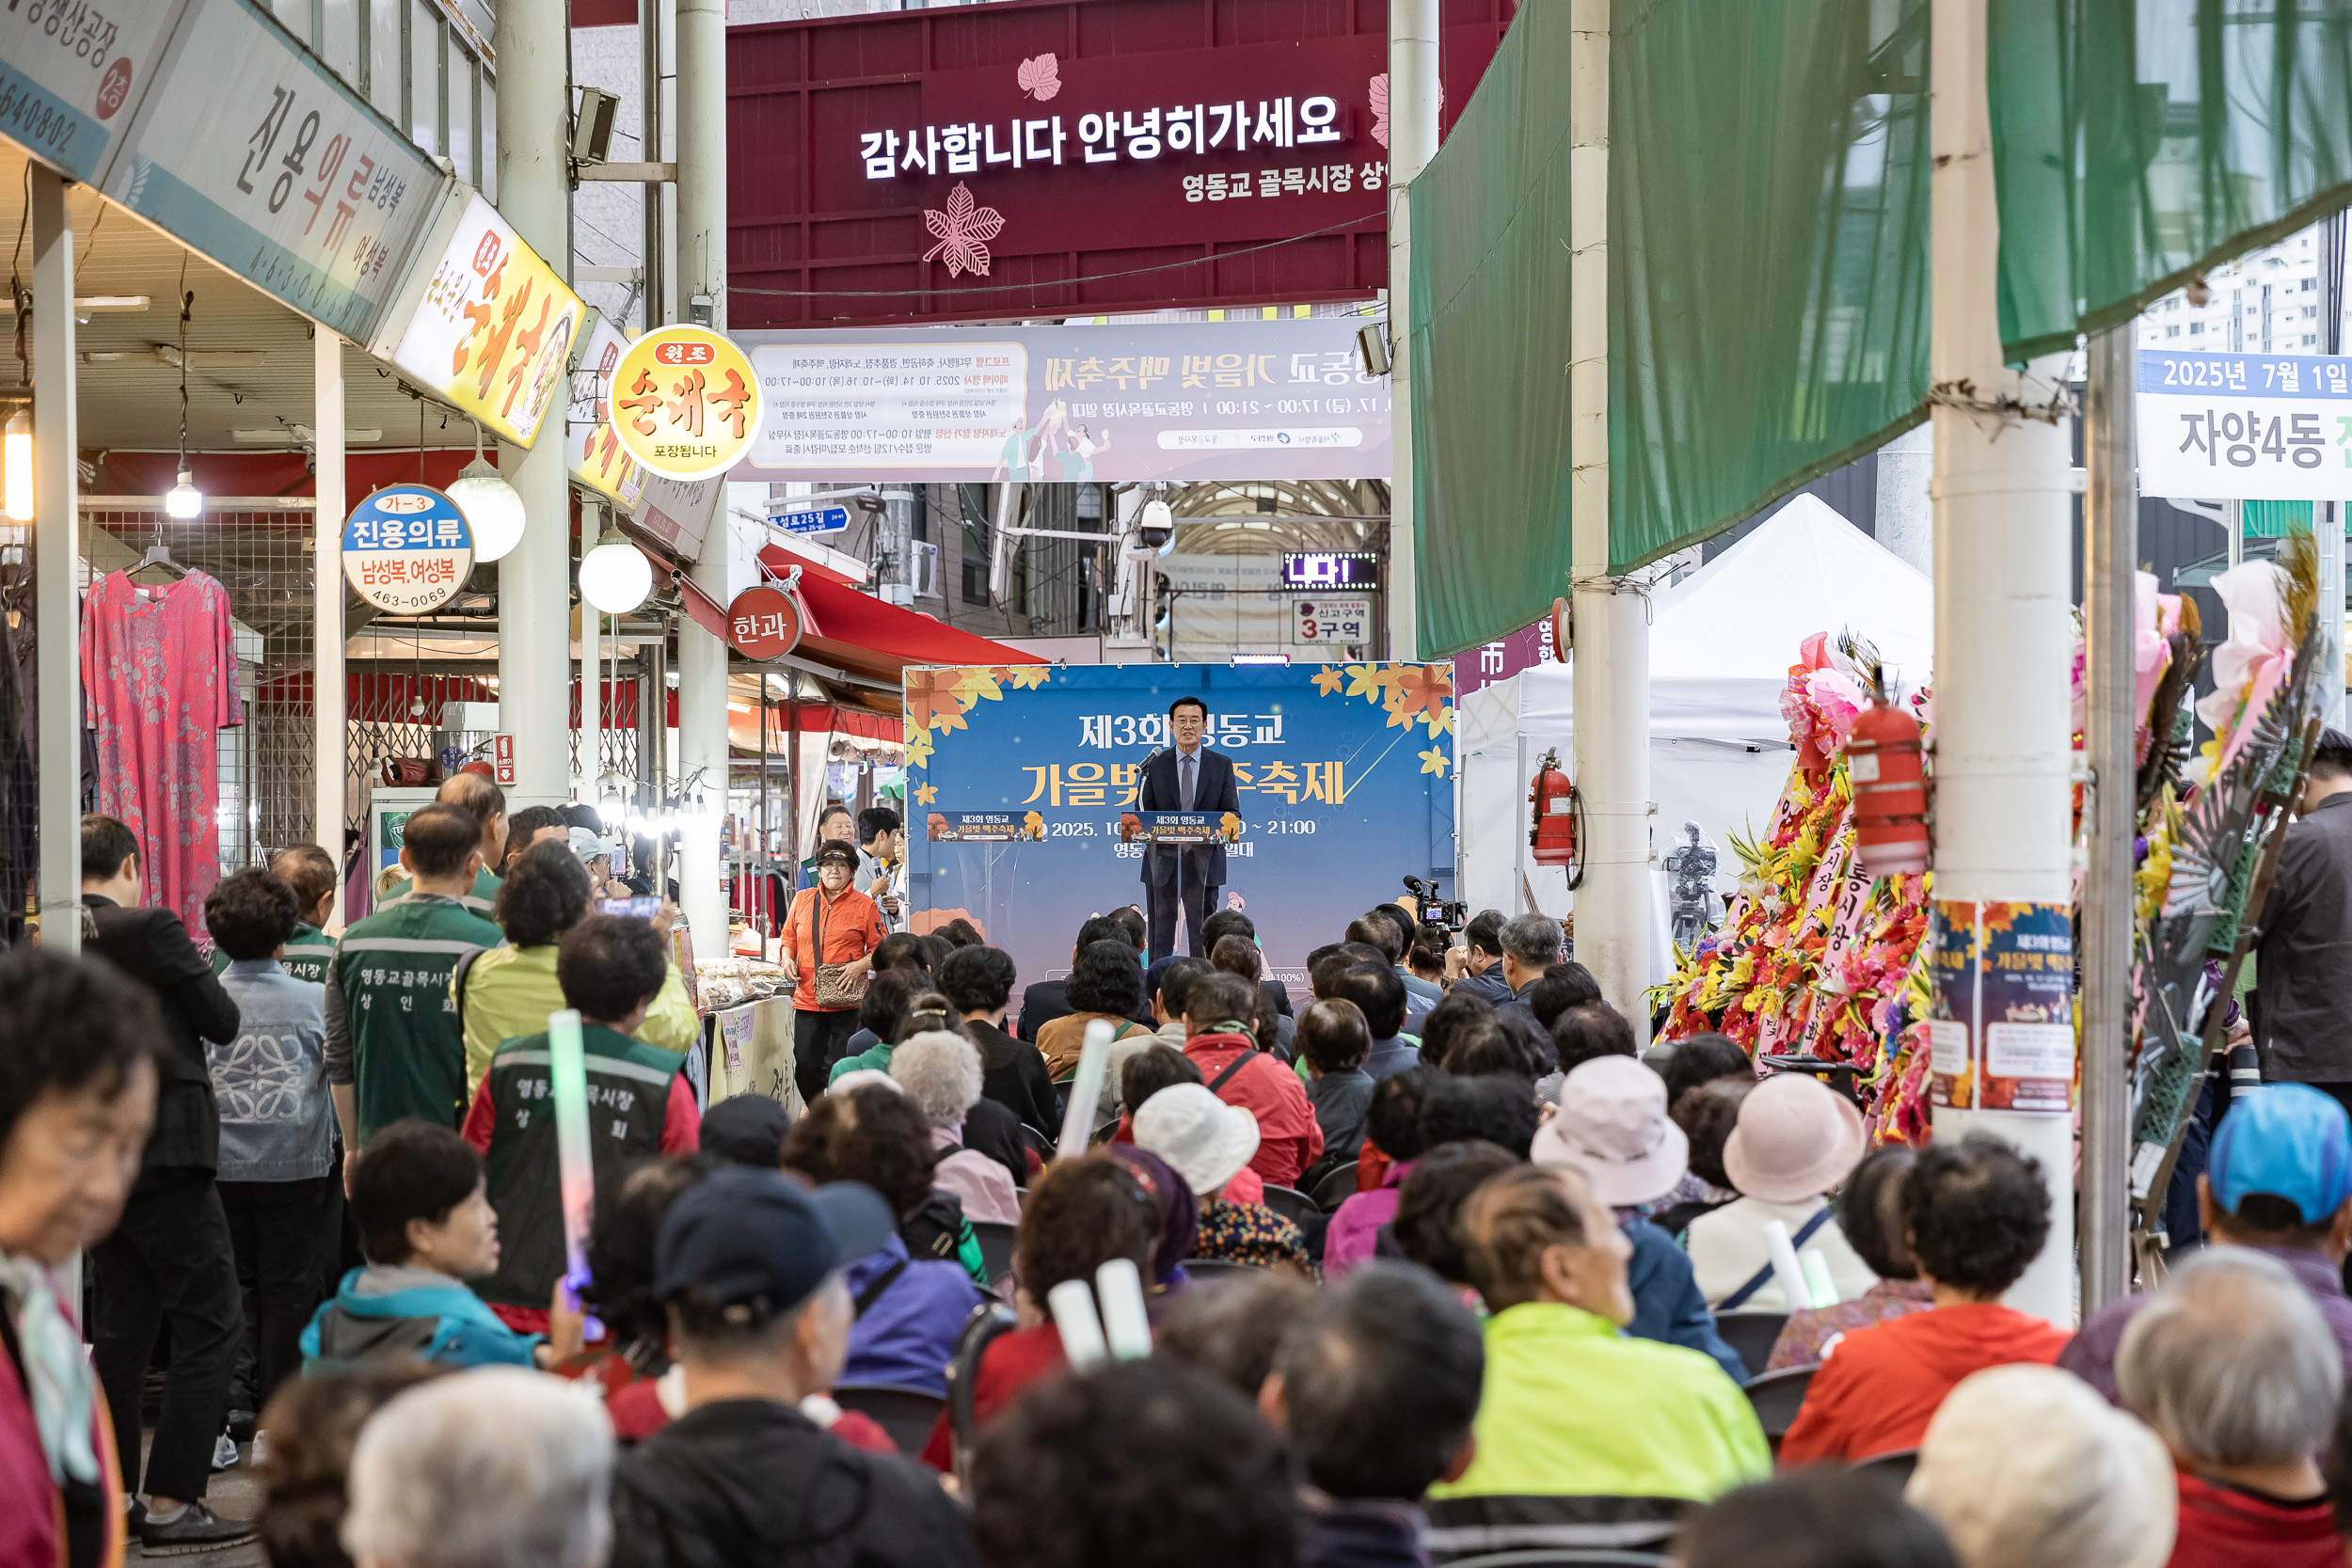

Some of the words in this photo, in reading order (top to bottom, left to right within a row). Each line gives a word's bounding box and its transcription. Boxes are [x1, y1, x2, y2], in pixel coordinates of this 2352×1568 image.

[860, 116, 1066, 180] 감사합니다
[1078, 96, 1341, 164] 안녕히가세요
[367, 165, 406, 218] 남성복
[1183, 173, 1252, 203] 영동교
[1258, 163, 1354, 198] 골목시장
[1360, 161, 1388, 190] 상
[353, 235, 390, 282] 여성복
[475, 234, 499, 270] 원조
[453, 252, 551, 419] 순대국
[664, 344, 707, 363] 원조
[2163, 360, 2247, 391] 2025년
[2262, 361, 2300, 394] 7월
[619, 367, 751, 439] 순대국
[654, 445, 717, 458] 포장됩니다
[2179, 410, 2325, 469] 자양4동
[353, 519, 463, 549] 진용의류
[373, 587, 447, 608] 463-0069
[733, 612, 787, 644] 한과
[1078, 713, 1171, 750] 제3회
[957, 824, 981, 833] 가을빛
[982, 824, 1015, 833] 맥주축제
[961, 815, 983, 824] 제3회
[985, 815, 1009, 824] 영동교
[1051, 822, 1098, 837] 2025.
[1268, 820, 1316, 836] 21:00
[1151, 826, 1175, 834] 가을빛
[1177, 826, 1211, 835] 맥주축제
[1156, 816, 1178, 825] 제3회
[1180, 816, 1205, 825] 영동교
